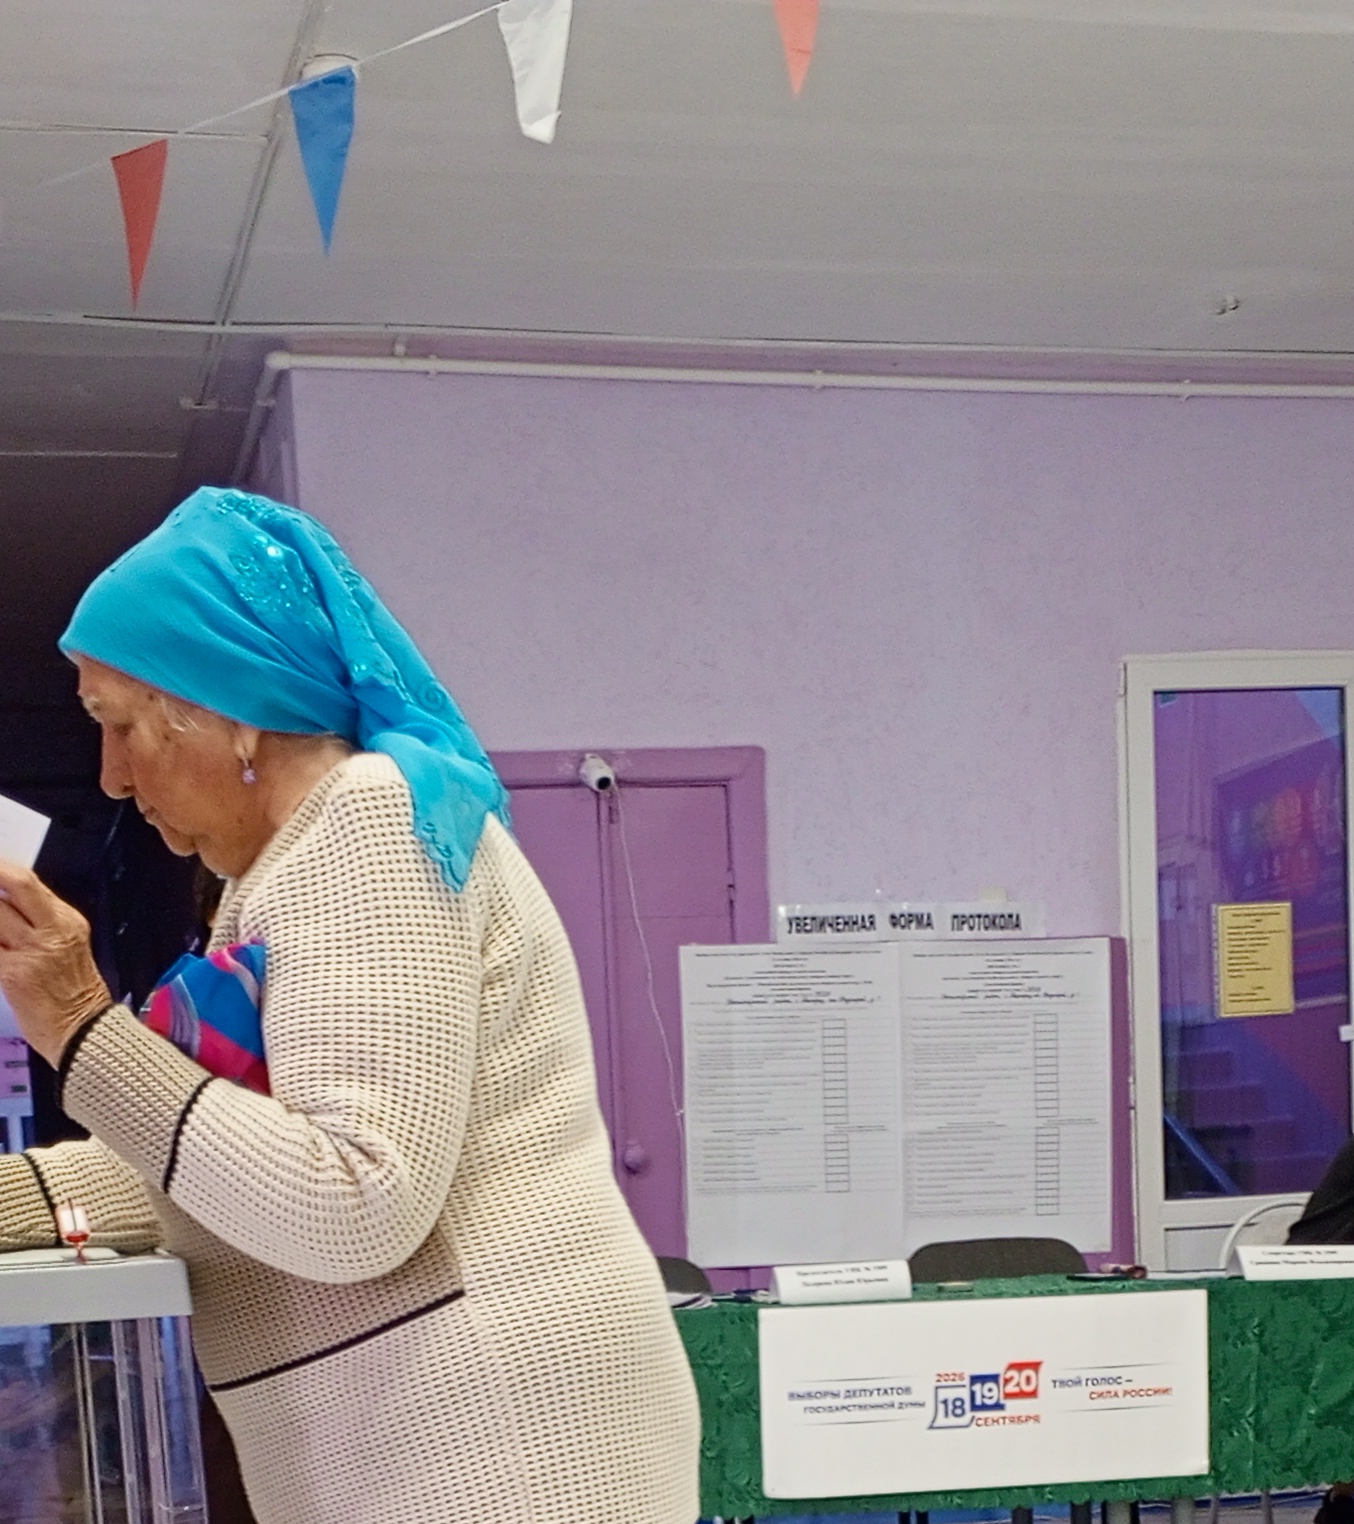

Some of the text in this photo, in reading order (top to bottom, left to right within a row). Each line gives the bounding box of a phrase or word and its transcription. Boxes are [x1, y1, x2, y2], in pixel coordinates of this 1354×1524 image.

[787, 912, 1022, 934] УВЕЛИЧЕННАЯ ФОРМА ПРОТОКОЛА
[935, 1372, 966, 1383] 2026
[1051, 1376, 1082, 1388] ТВОЙ
[1085, 1376, 1122, 1387] ГОЛОС
[788, 1386, 913, 1401] ВЫБОРЫ ДЕПУТАТОВ
[940, 1369, 1038, 1418] 18 19 20
[1089, 1389, 1120, 1400] СИЛА
[975, 1415, 1041, 1427] СЕНТЯБРЯ
